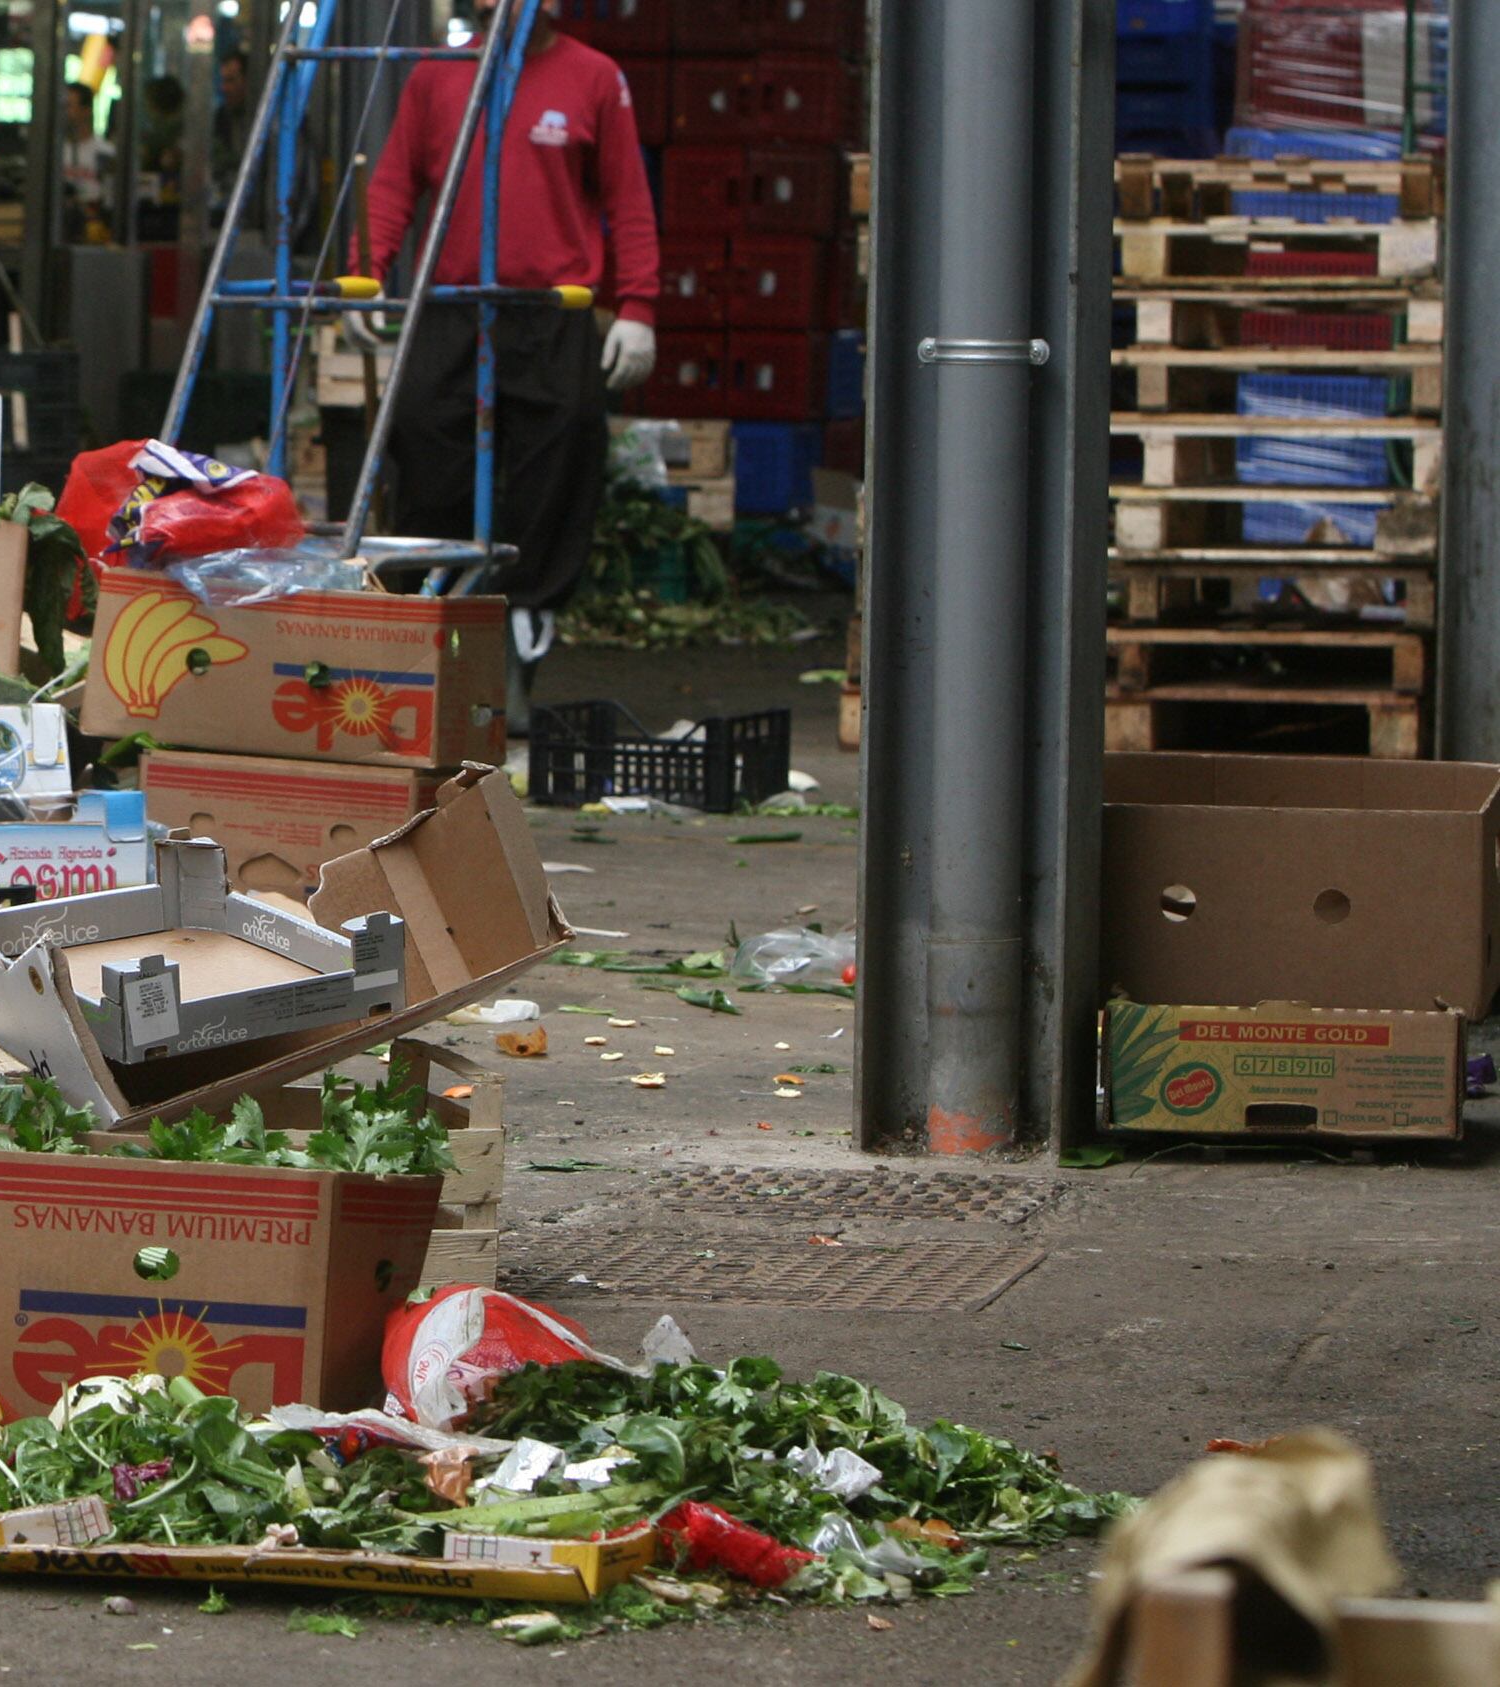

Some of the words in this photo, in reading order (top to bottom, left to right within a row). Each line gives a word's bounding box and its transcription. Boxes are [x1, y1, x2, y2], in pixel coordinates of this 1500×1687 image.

[275, 619, 351, 640] BANANAS
[355, 626, 426, 644] PREMIUM
[272, 678, 435, 758] Dole
[58, 846, 102, 862] Agricola
[242, 917, 291, 951] ortofelice
[177, 1022, 248, 1051] ortofelice
[1195, 1024, 1231, 1039] DEL
[1238, 1025, 1307, 1041] MONTE
[1314, 1027, 1368, 1042] GOLD
[1240, 1060, 1250, 1072] 6
[1258, 1060, 1268, 1072] 7
[1278, 1060, 1288, 1073] 8
[1296, 1061, 1306, 1074] 9
[1314, 1061, 1331, 1074] 10
[13, 1203, 156, 1237] BANANAS
[168, 1213, 312, 1246] PREMIUM
[343, 1562, 469, 1589] Melinda
